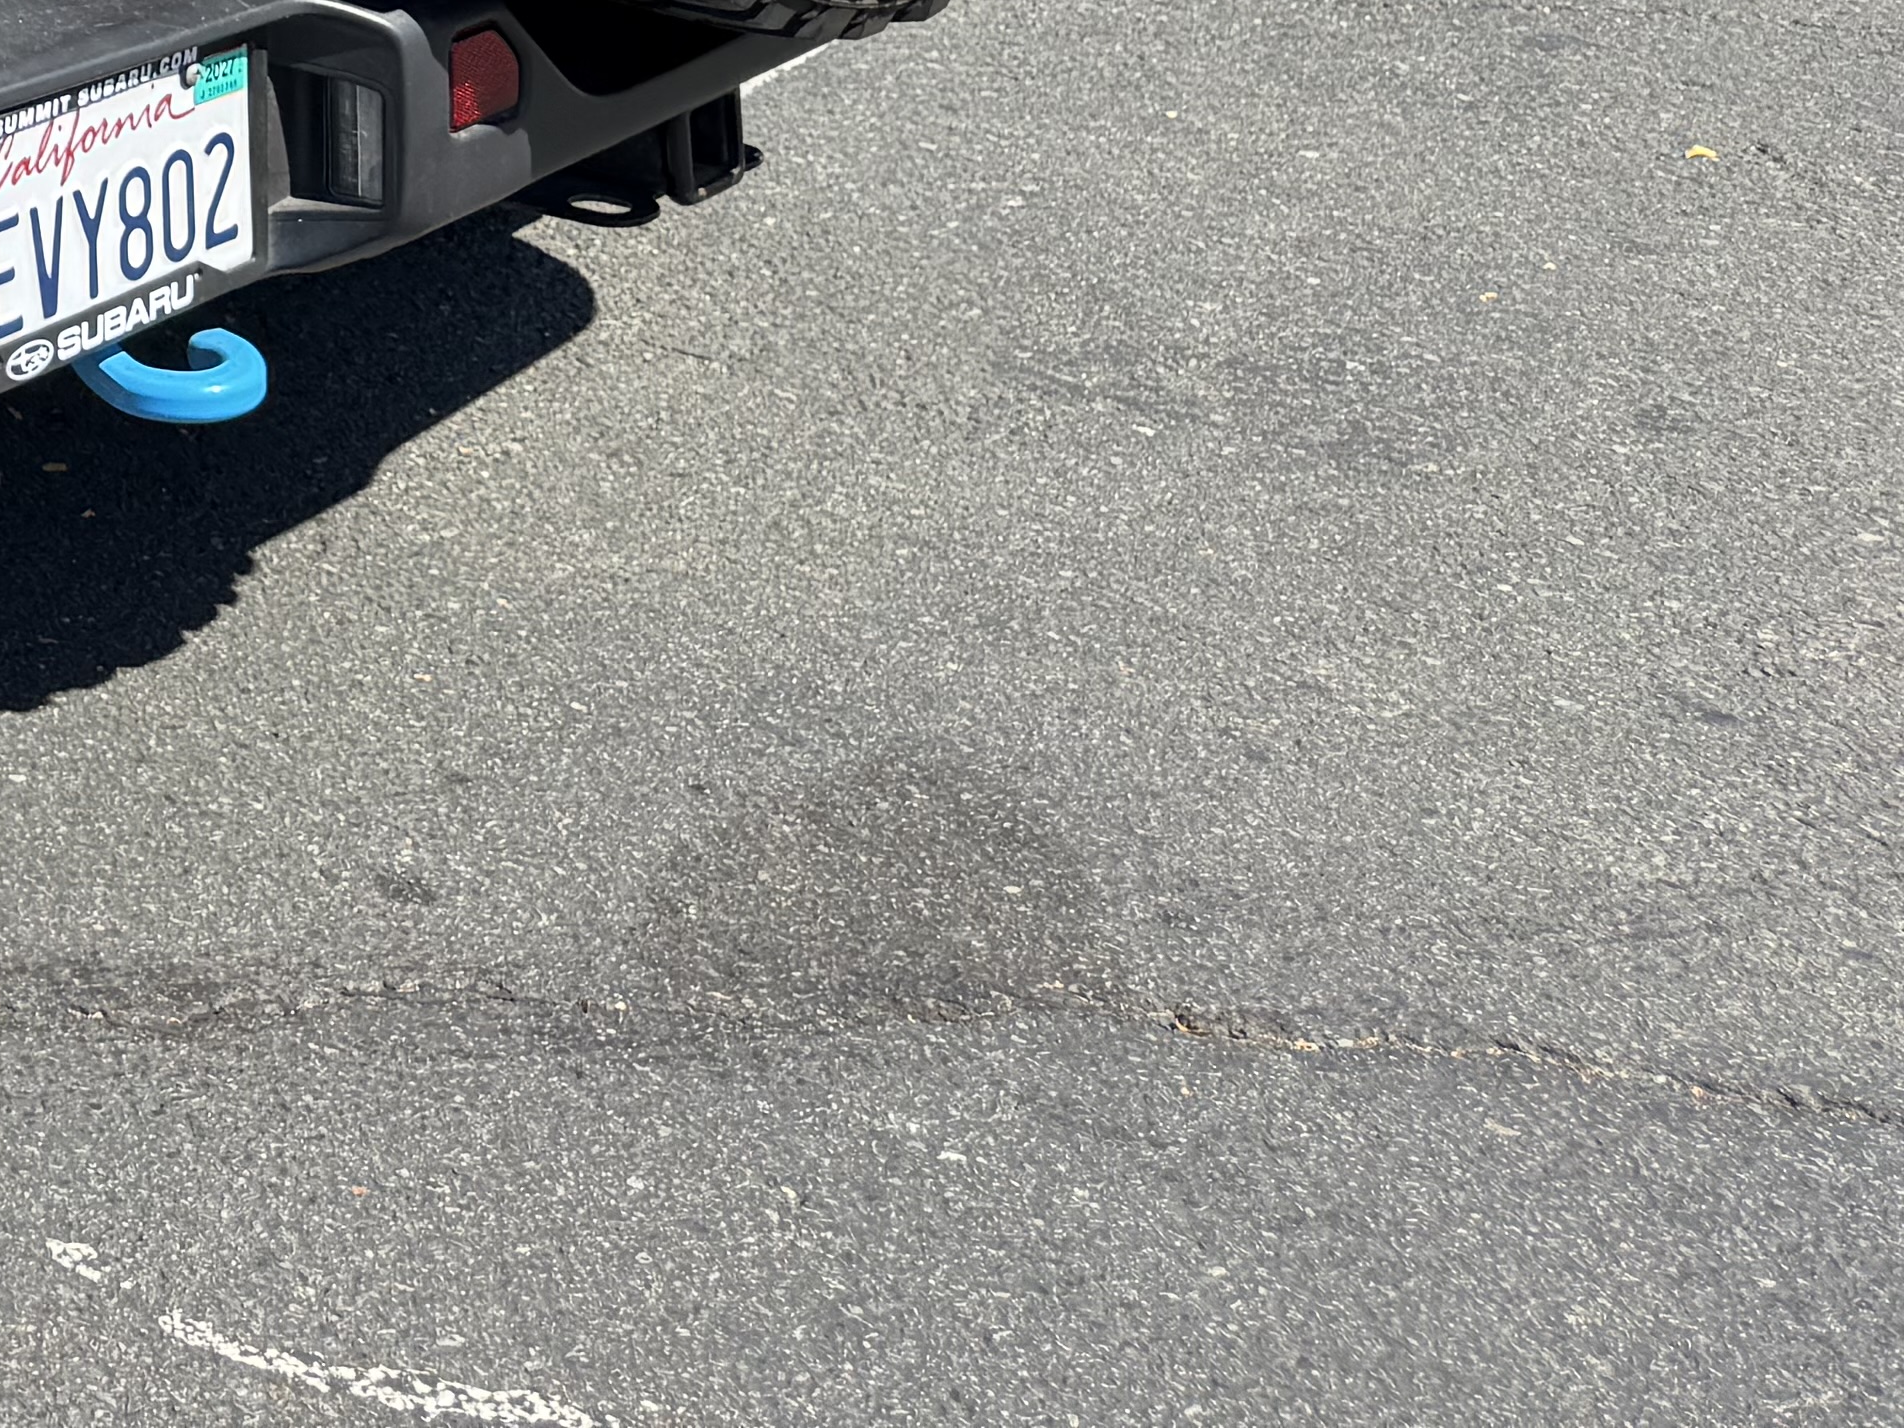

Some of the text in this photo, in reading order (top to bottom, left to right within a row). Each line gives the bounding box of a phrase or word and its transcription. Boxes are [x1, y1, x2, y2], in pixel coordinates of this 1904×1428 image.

[77, 46, 198, 108] SUBARU.COM
[204, 58, 235, 83] 2027
[55, 275, 195, 362] SUBARU
